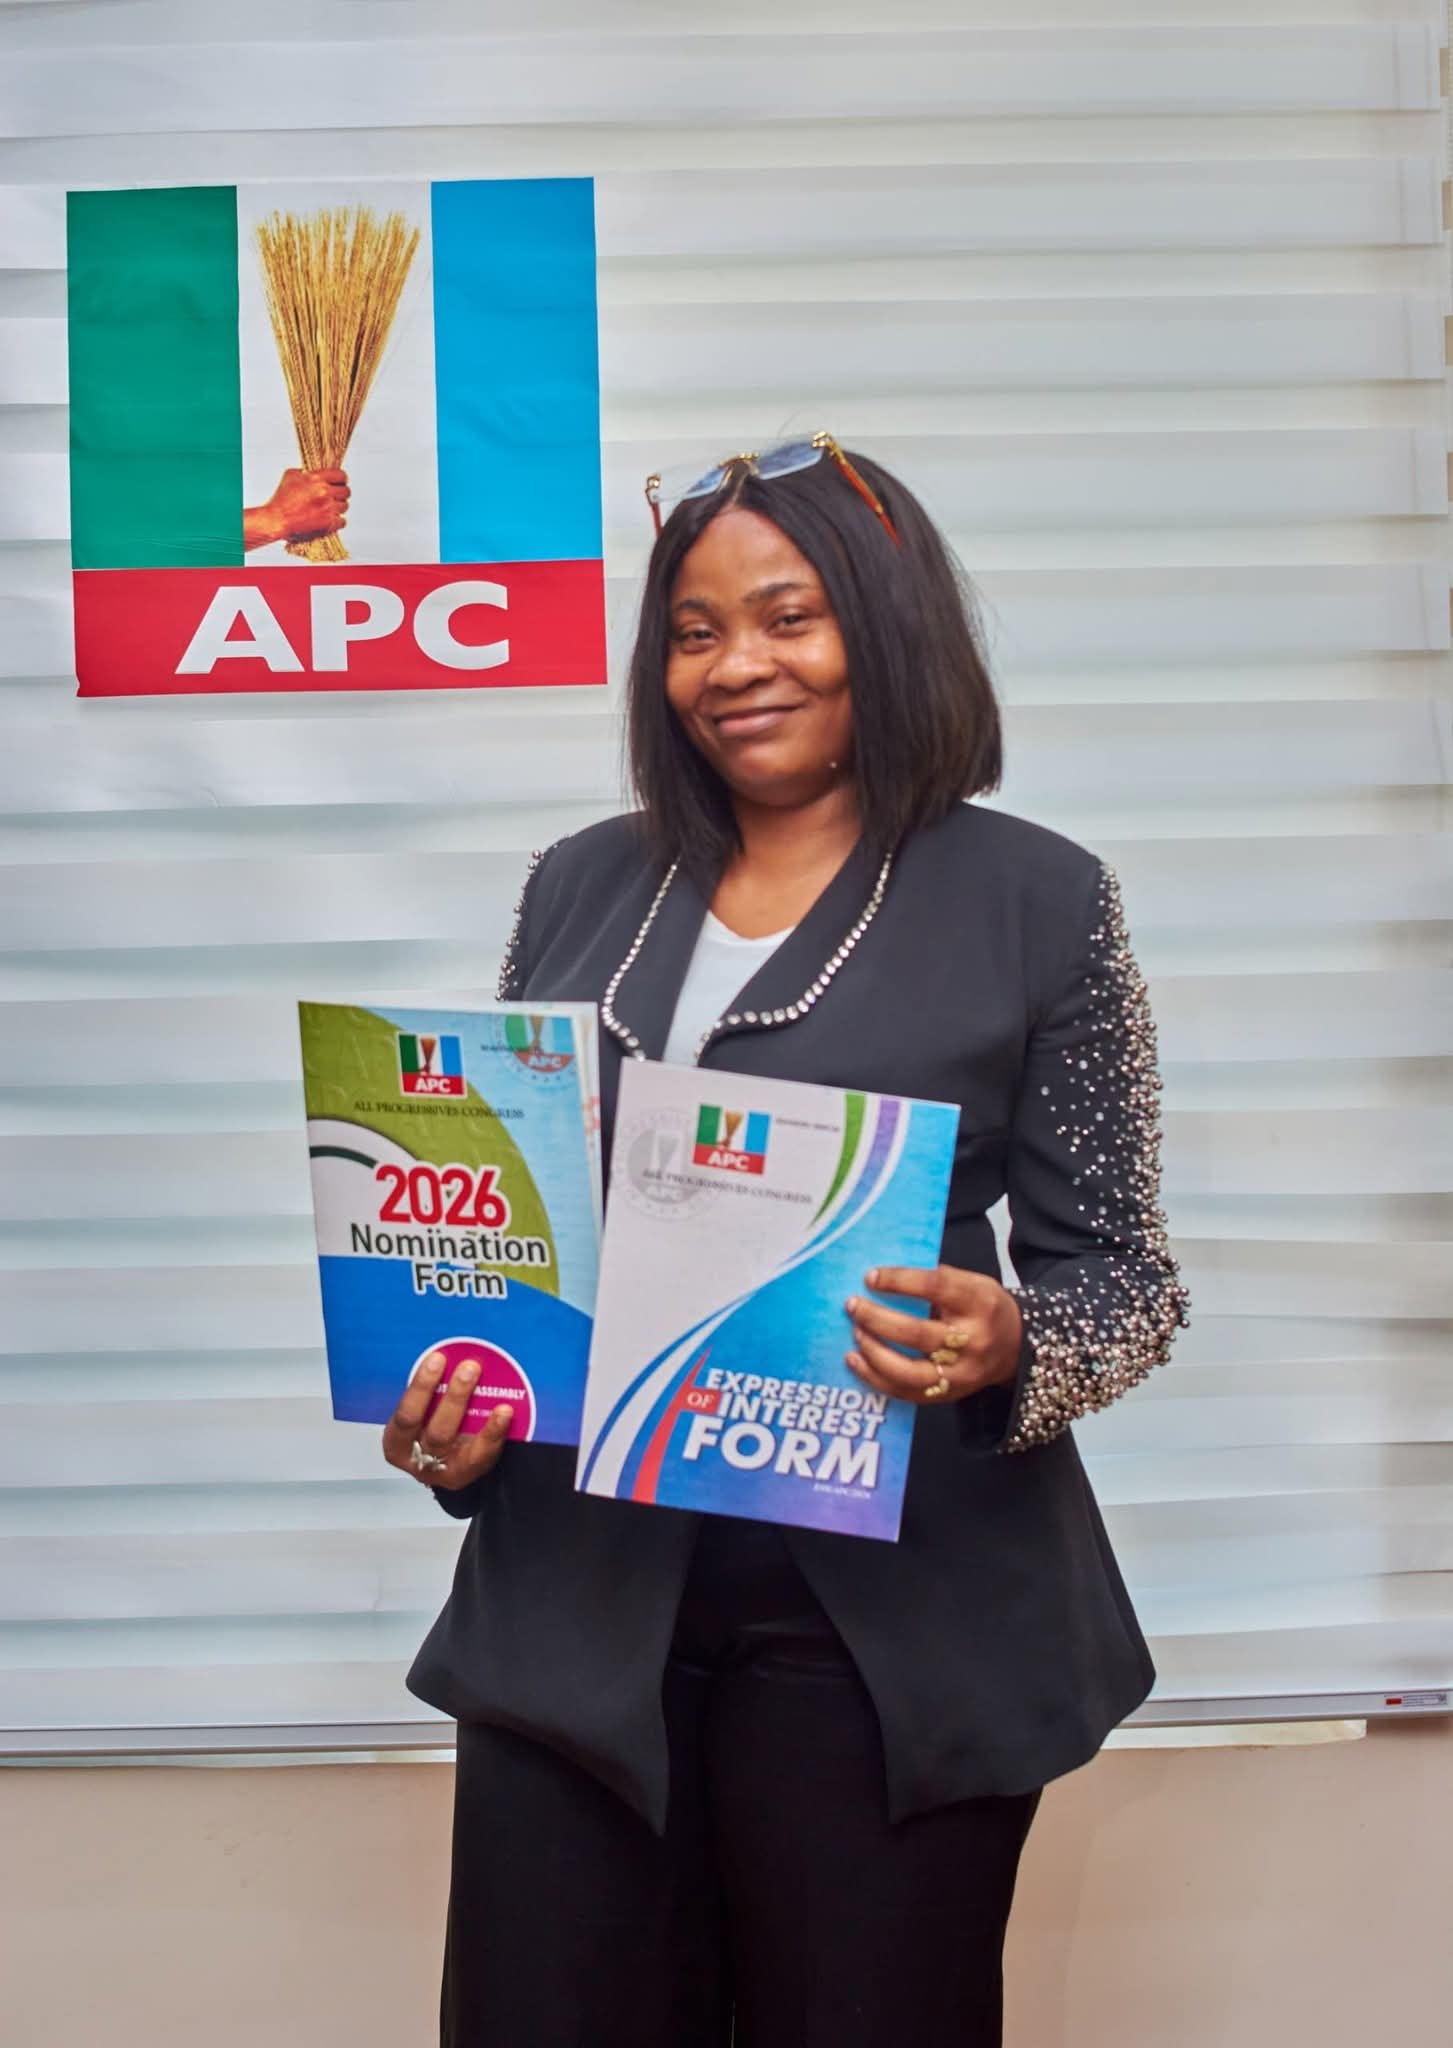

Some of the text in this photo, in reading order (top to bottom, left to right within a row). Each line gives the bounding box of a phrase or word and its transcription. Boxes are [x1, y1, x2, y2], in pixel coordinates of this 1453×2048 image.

[174, 580, 510, 675] APC
[415, 1077, 451, 1093] APC
[353, 1101, 525, 1119] ALL PROGRESSIVES CONGRESS
[707, 1151, 751, 1171] APC
[375, 1164, 507, 1228] 2026
[351, 1222, 548, 1263] Nomination
[414, 1262, 505, 1296] Form
[474, 1385, 526, 1400] ASSEMBLY
[706, 1367, 888, 1416] EXPRESSION
[687, 1391, 885, 1440] OF INTEREST
[682, 1413, 881, 1489] FORM
